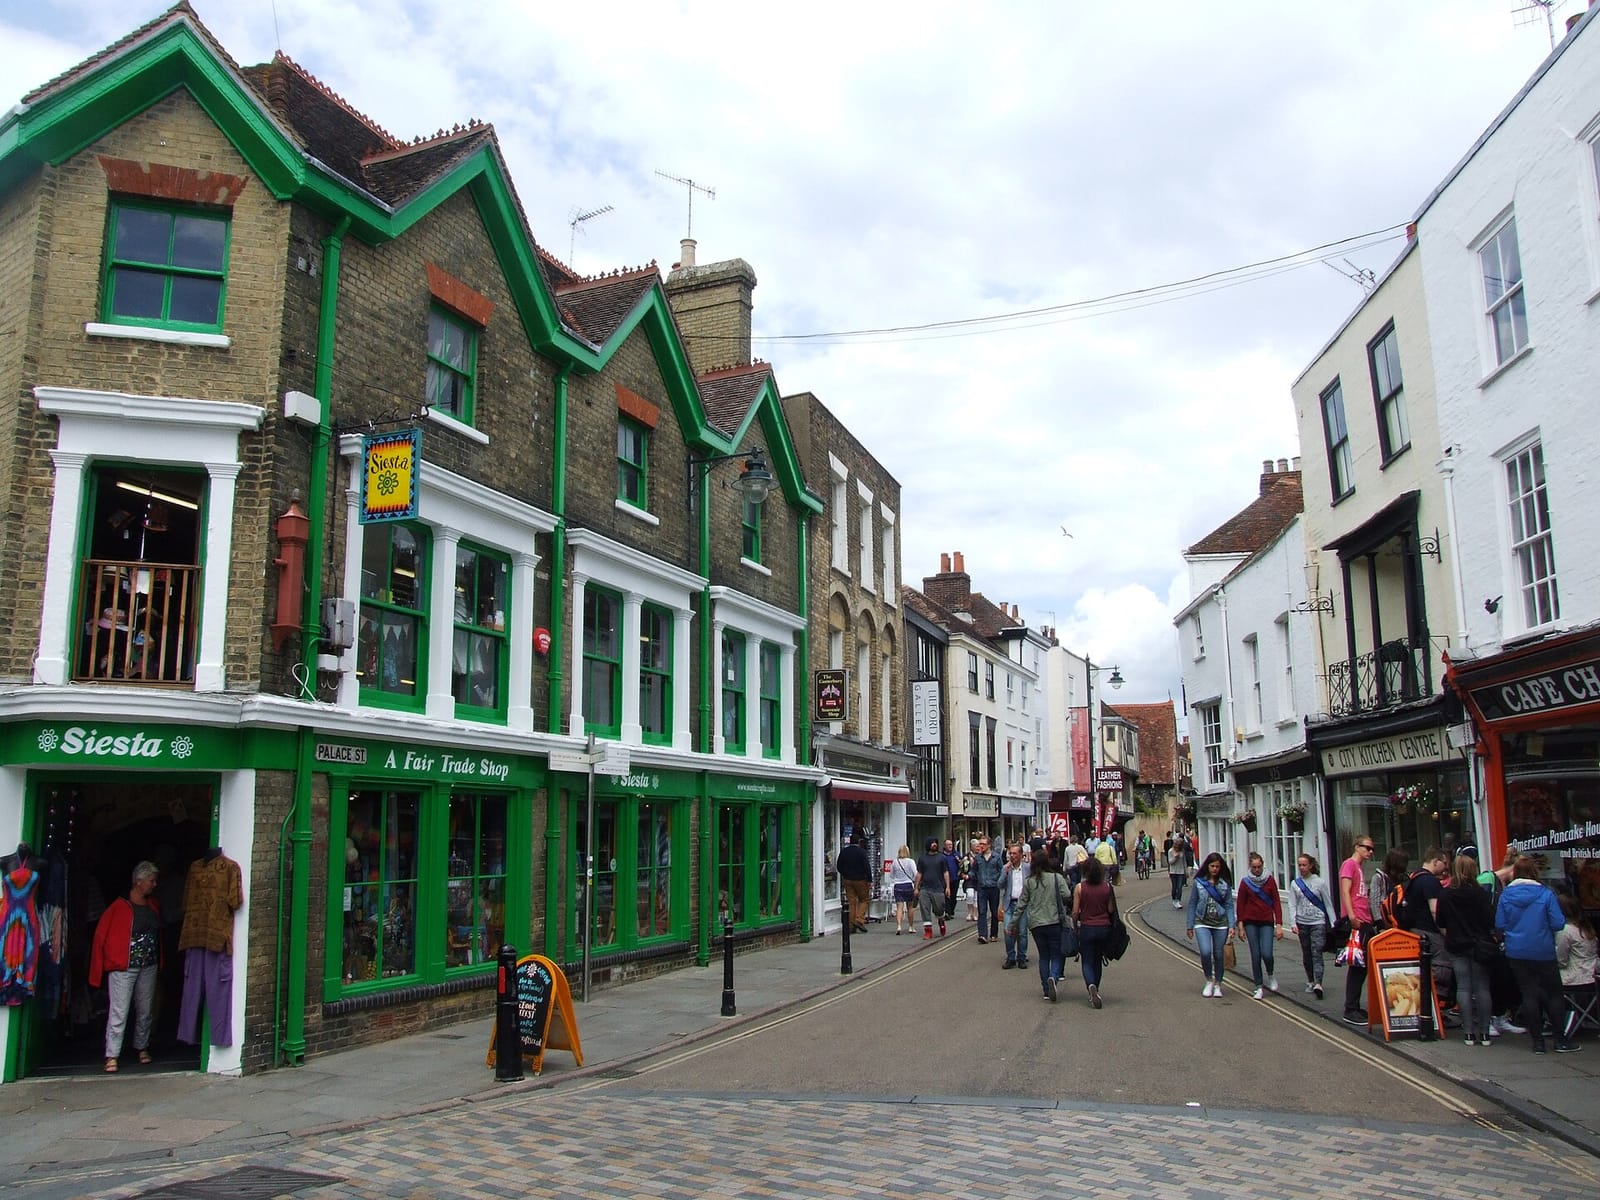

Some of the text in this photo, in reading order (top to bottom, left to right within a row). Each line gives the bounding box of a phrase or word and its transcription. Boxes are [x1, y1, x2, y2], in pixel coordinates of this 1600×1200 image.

[370, 452, 409, 474] Siesta
[1501, 665, 1600, 712] CAFE CH
[914, 684, 923, 742] GALLERY
[60, 726, 164, 758] Siesta
[317, 745, 352, 761] PALACE
[1338, 733, 1440, 768] CITY KITCHEN CENTRE
[384, 749, 509, 781] A Fair Trade Shop
[1097, 771, 1121, 780] LEATHER
[620, 772, 649, 788] Siesta
[1096, 780, 1123, 790] FASHIONS
[1512, 820, 1600, 852] American Pancake Hou
[1560, 848, 1571, 858] and
[1572, 848, 1592, 858] British
